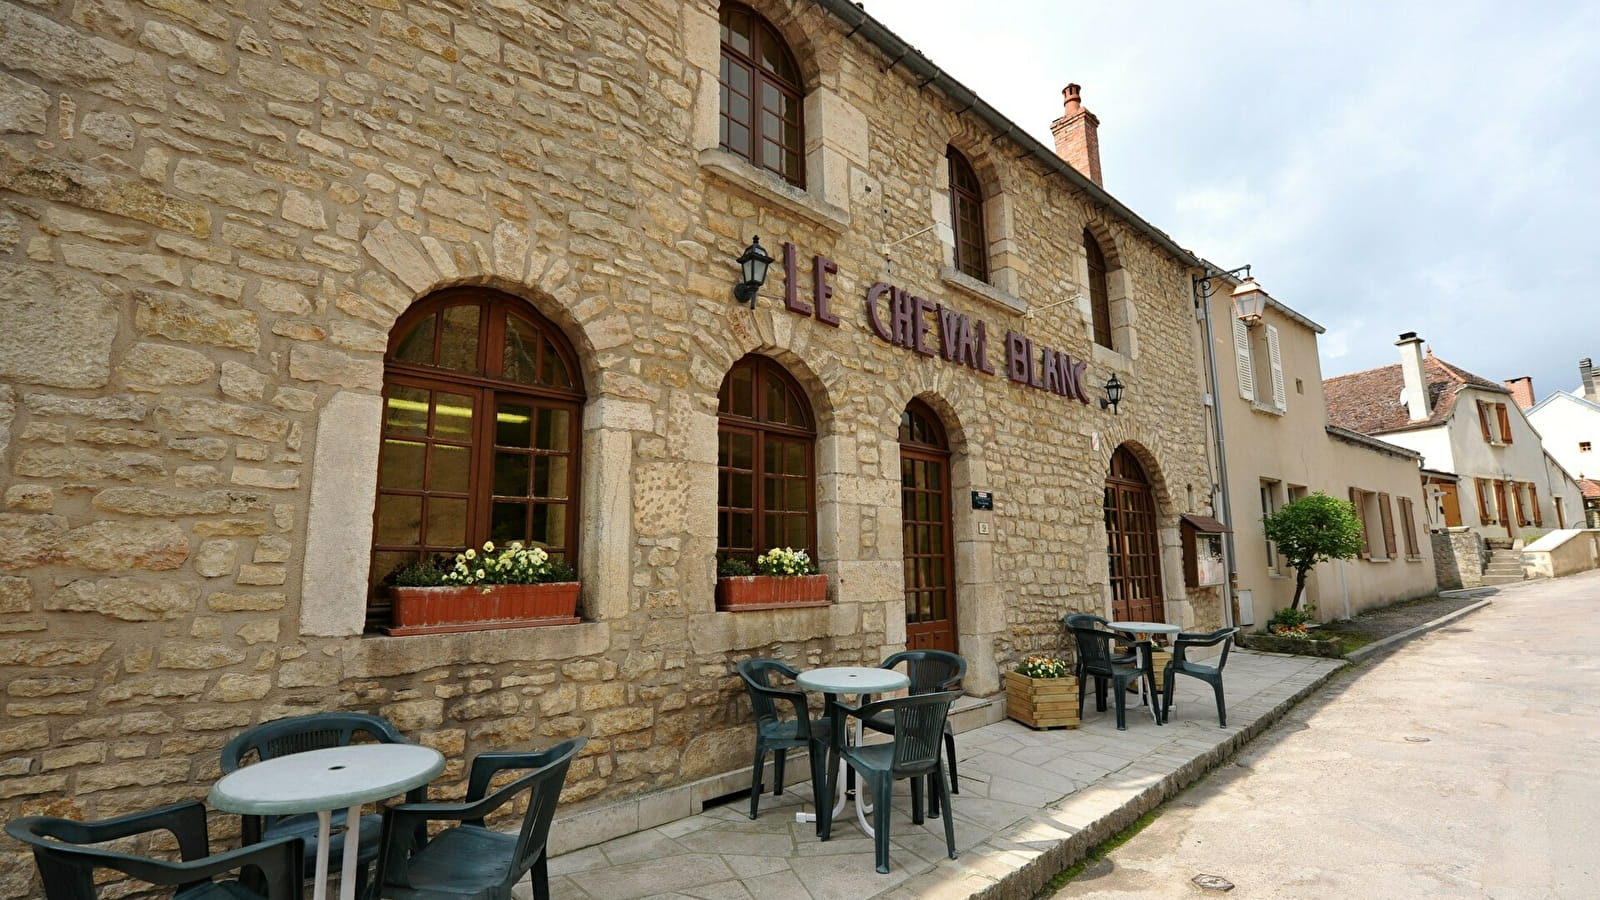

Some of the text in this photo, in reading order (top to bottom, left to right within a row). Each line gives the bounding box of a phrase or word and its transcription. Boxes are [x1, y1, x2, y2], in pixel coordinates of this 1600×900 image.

[784, 241, 1089, 404] LE CHEVAL BLANC
